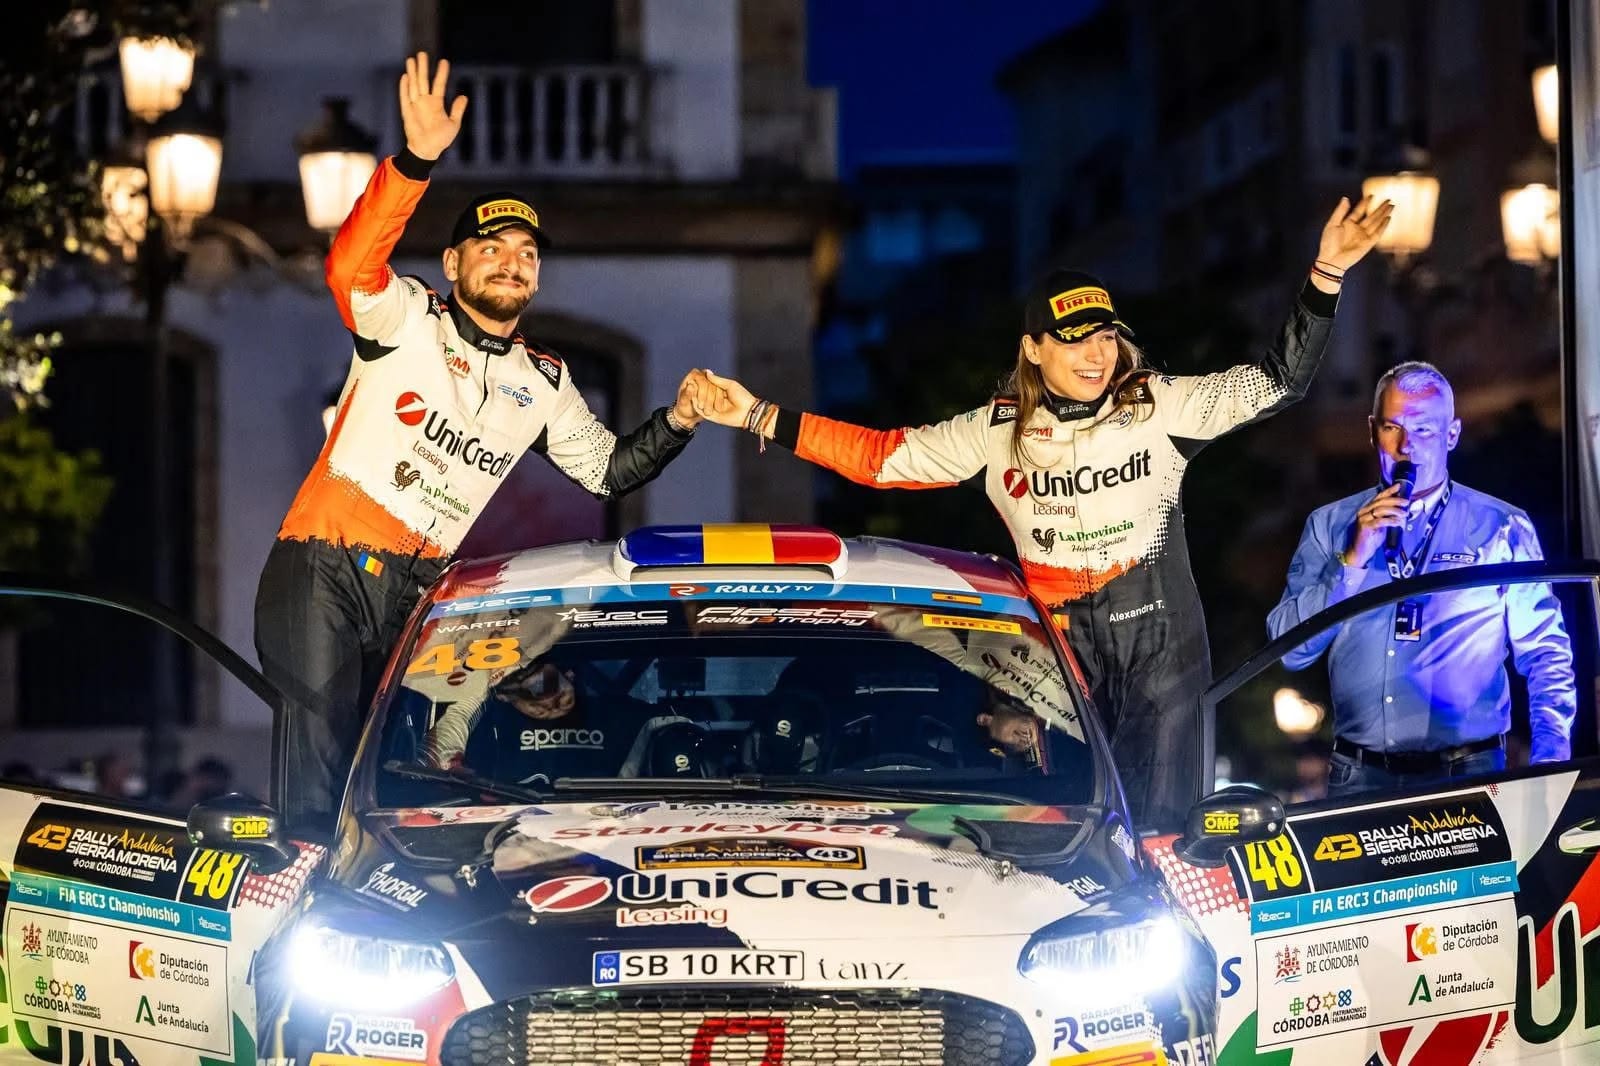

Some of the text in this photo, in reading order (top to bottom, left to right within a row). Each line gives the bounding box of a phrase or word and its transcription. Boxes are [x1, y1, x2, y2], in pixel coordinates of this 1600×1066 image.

[512, 391, 533, 404] FUCHS
[998, 407, 1017, 417] OM
[424, 411, 514, 478] UniCredit
[412, 440, 449, 475] Leasing
[1032, 449, 1151, 497] UniCredit
[419, 479, 432, 495] La
[1033, 503, 1076, 518] Leasing
[1059, 520, 1134, 542] La Provincia
[715, 585, 790, 593] RALLY
[574, 610, 668, 622] ERC
[697, 606, 879, 619] Fiesta
[1110, 600, 1165, 622] Alexandra T.
[437, 619, 521, 634] WARTER
[407, 637, 521, 675] 48
[520, 729, 604, 751] sparco
[232, 821, 268, 834] OMP
[1205, 817, 1240, 829] OMP
[27, 824, 71, 850] 43
[72, 829, 118, 844] RALLY
[1314, 834, 1363, 861] 43
[1359, 824, 1410, 844] RALLY
[812, 850, 850, 859] 48
[1244, 834, 1302, 890] 48
[1409, 846, 1452, 862] CÓRDOBA
[96, 861, 133, 877] CÓRDOBA
[187, 848, 243, 900] 48
[621, 872, 938, 909] UniCredit
[1312, 878, 1458, 915] FIA ERC3 Championship
[59, 887, 181, 925] FIA ERC3 Championship
[621, 906, 728, 924] Leasing
[1442, 919, 1498, 939] Diputación
[46, 929, 98, 950] AYUNTAMIENTO
[1306, 935, 1369, 958] AYUNTAMIENTO
[1443, 933, 1499, 951] de Córdoba
[46, 945, 90, 965] DE CÓRDOBA
[160, 953, 209, 973] Diputación
[1306, 954, 1360, 974] DE CÓRDOBA
[600, 954, 798, 979] RO SB 10 KRT
[160, 968, 209, 987] de Córdoba
[1435, 977, 1494, 997] de Andalucía
[1436, 971, 1462, 984] Junta
[24, 993, 71, 1014] CÓRDOBA
[157, 1000, 180, 1014] Junta
[158, 1014, 209, 1033] de Andalucía
[1083, 1012, 1146, 1038] ROGER
[1273, 1013, 1330, 1034] CÓRDOBA
[1332, 1012, 1367, 1024] HUMANIDAD
[356, 1028, 424, 1048] ROGER
